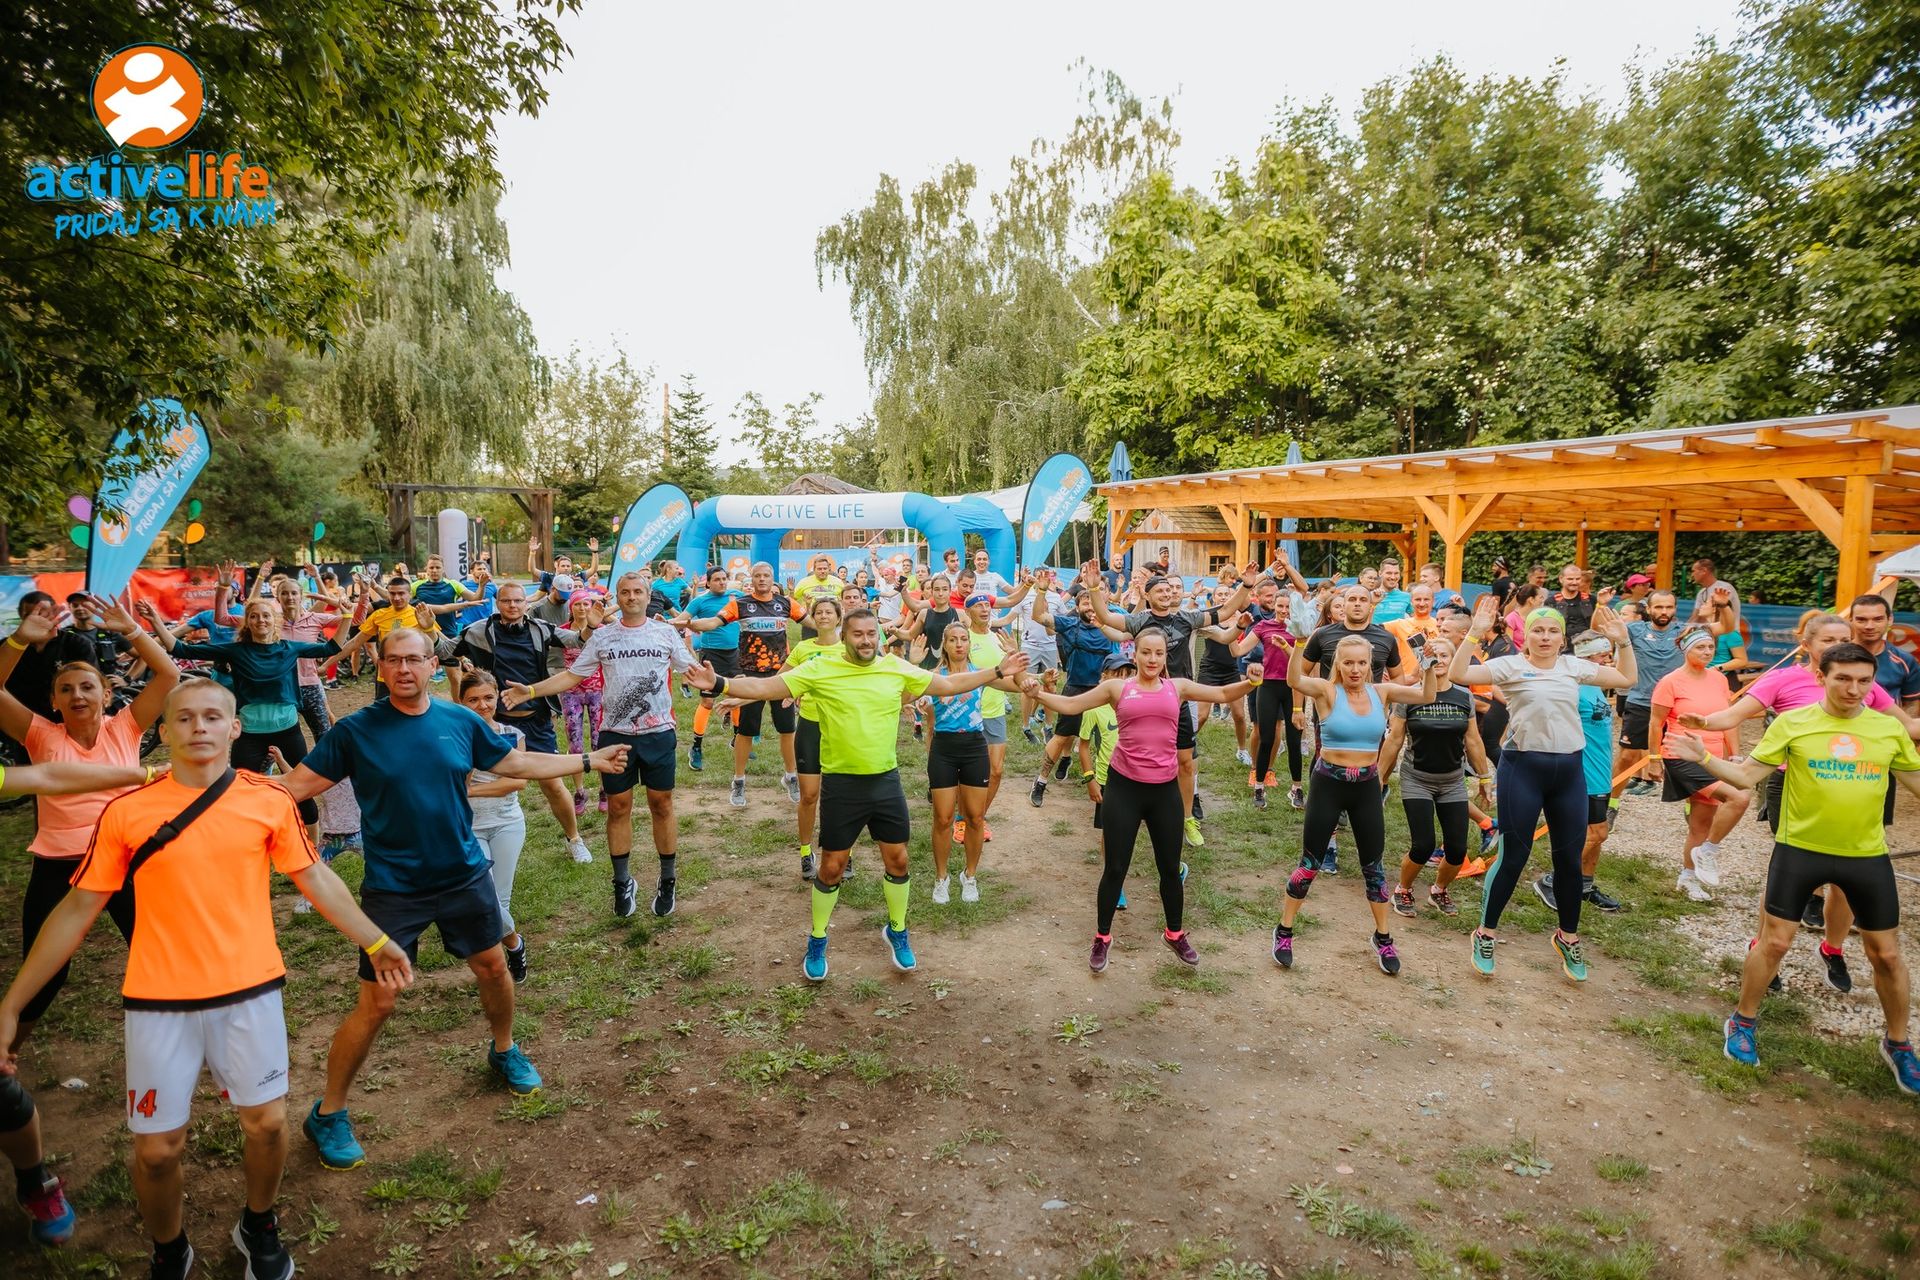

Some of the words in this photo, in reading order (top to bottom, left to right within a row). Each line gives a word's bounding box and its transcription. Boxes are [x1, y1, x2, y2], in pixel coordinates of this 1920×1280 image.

[135, 494, 165, 536] PRIDAJ
[162, 480, 178, 497] SA
[751, 504, 816, 519] ACTIVE
[828, 503, 865, 519] LIFE
[618, 649, 662, 658] MAGNA
